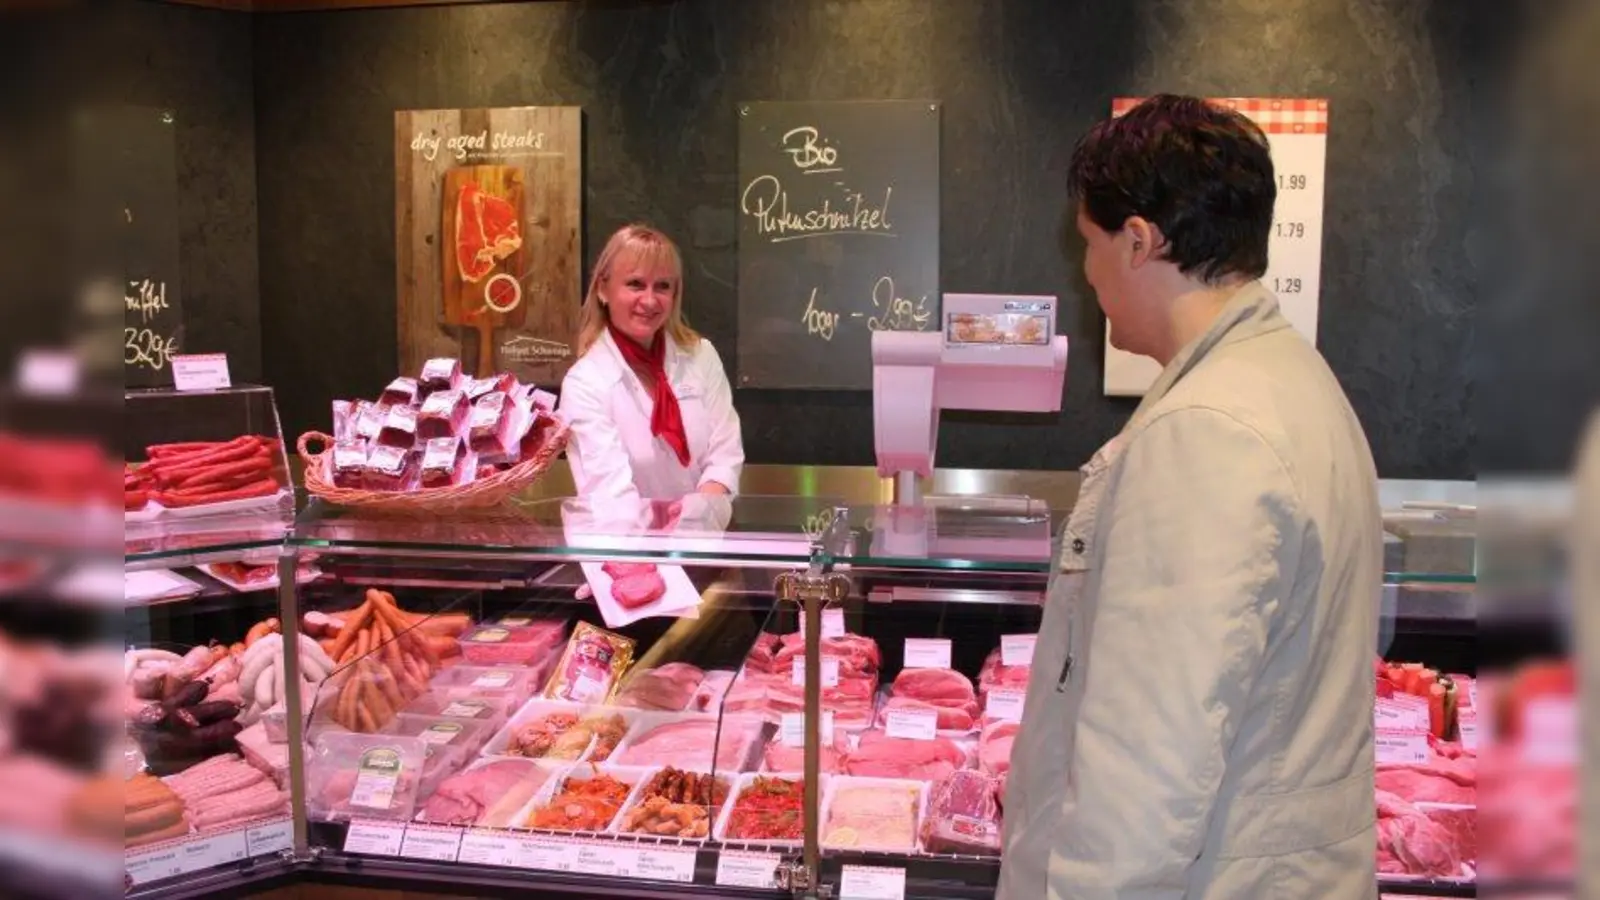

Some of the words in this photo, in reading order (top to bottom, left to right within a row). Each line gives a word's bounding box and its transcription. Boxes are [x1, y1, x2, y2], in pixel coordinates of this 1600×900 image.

[410, 132, 442, 161] dry
[447, 130, 488, 159] aged
[492, 129, 545, 150] steaks
[1279, 174, 1306, 190] 1.99
[1275, 222, 1304, 238] 1.79
[1274, 278, 1302, 293] 1.29
